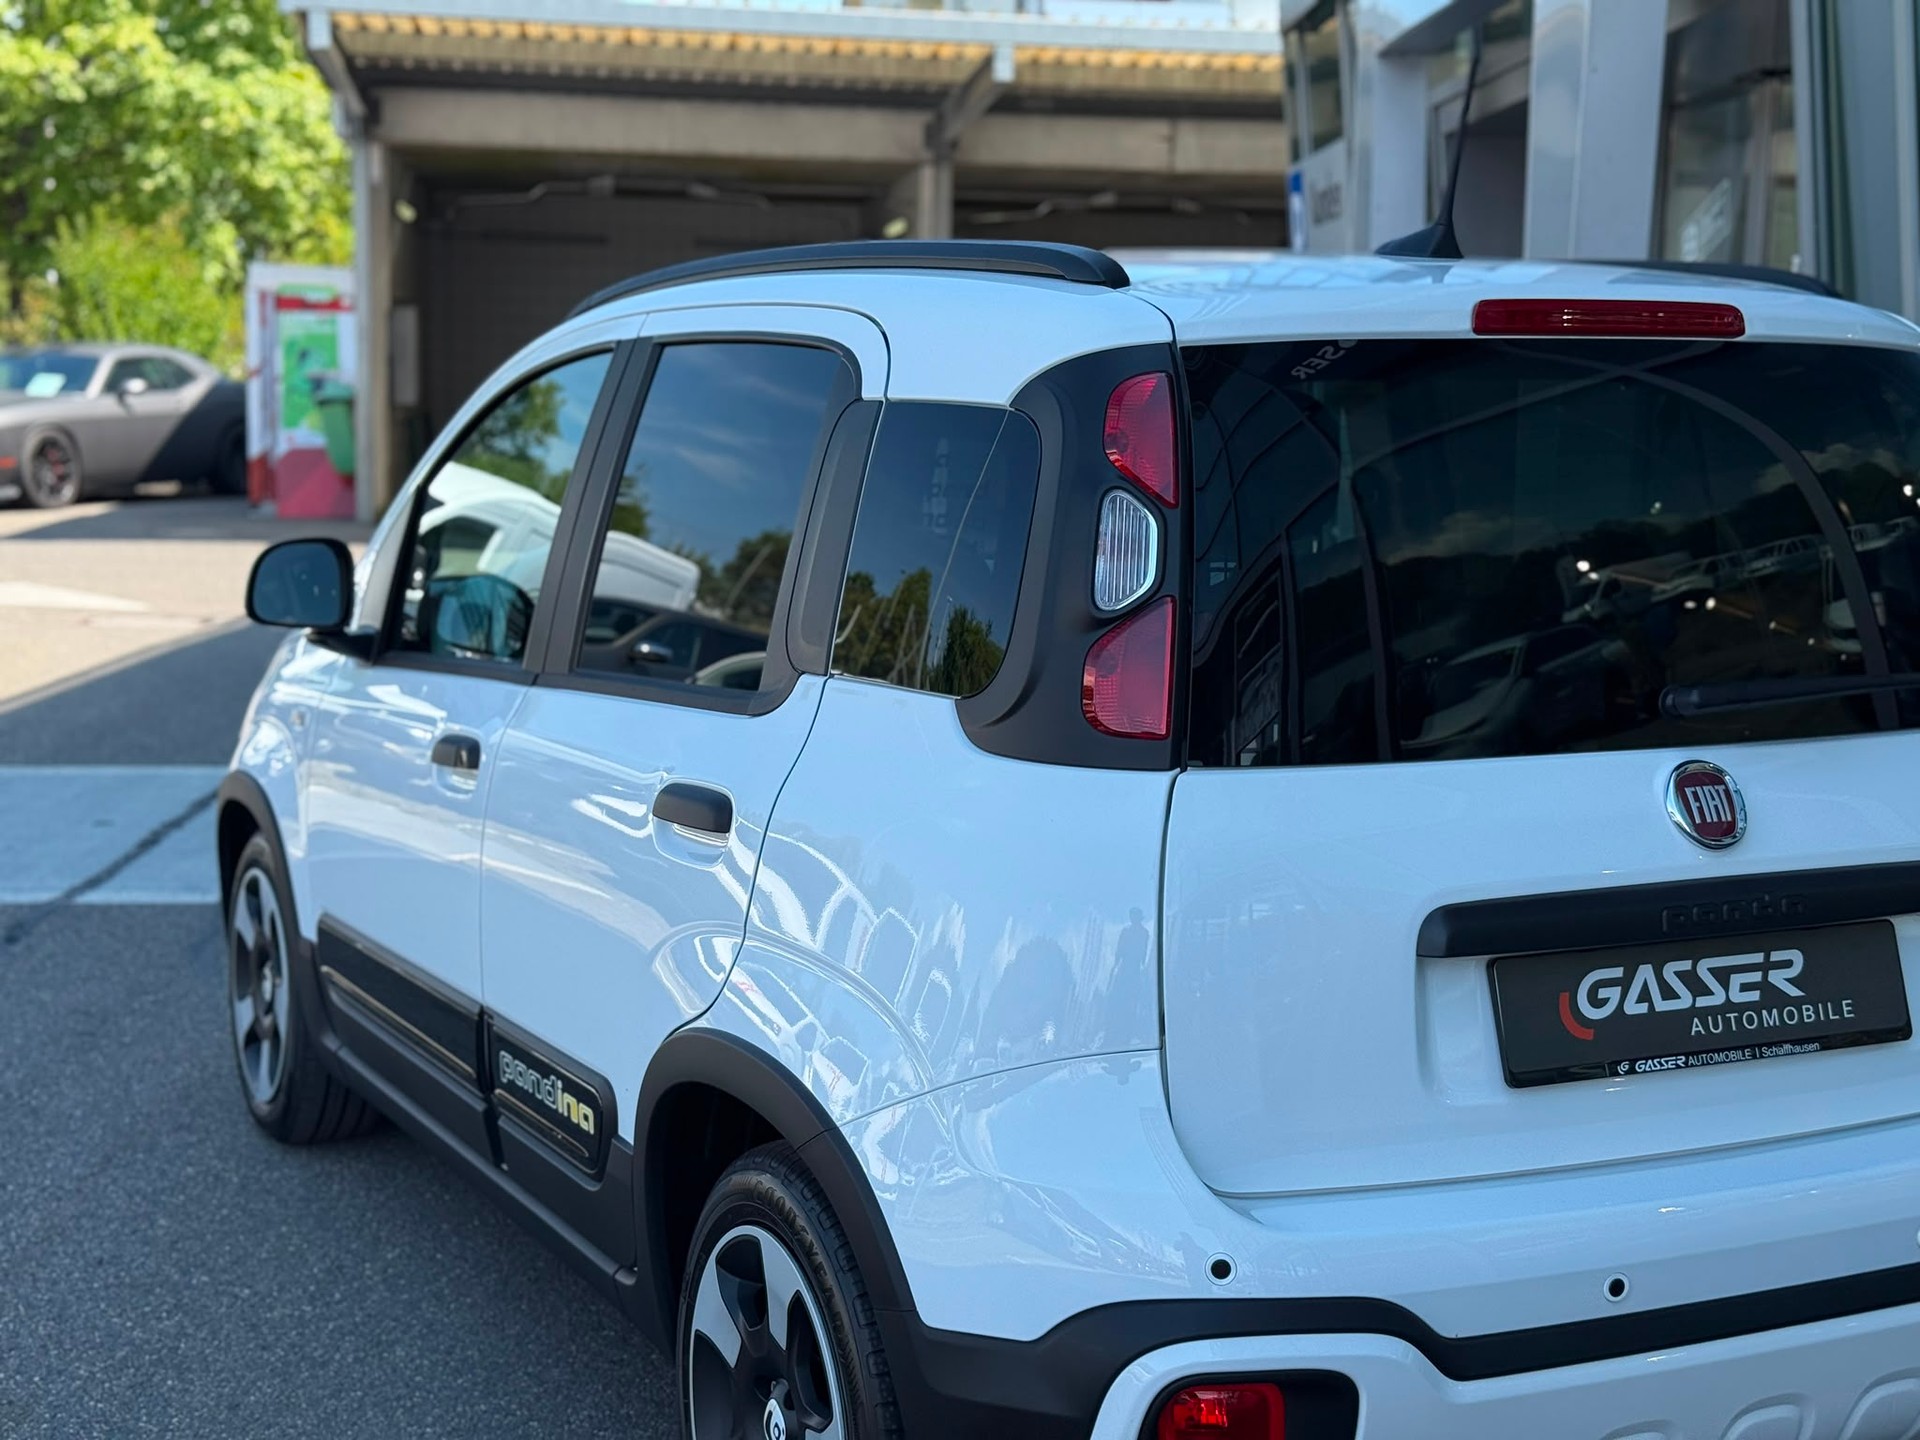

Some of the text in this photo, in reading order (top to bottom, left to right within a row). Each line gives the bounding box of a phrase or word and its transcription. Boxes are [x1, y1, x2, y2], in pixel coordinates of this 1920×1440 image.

[1684, 784, 1732, 824] FIAT
[1577, 948, 1806, 1020] GASSER
[1690, 999, 1855, 1036] AUTOMOBILE
[1635, 1055, 1686, 1072] GASSER
[1688, 1048, 1753, 1066] AUTOMOBILE
[1761, 1042, 1820, 1057] Schaffhausen
[499, 1049, 595, 1135] pandina
